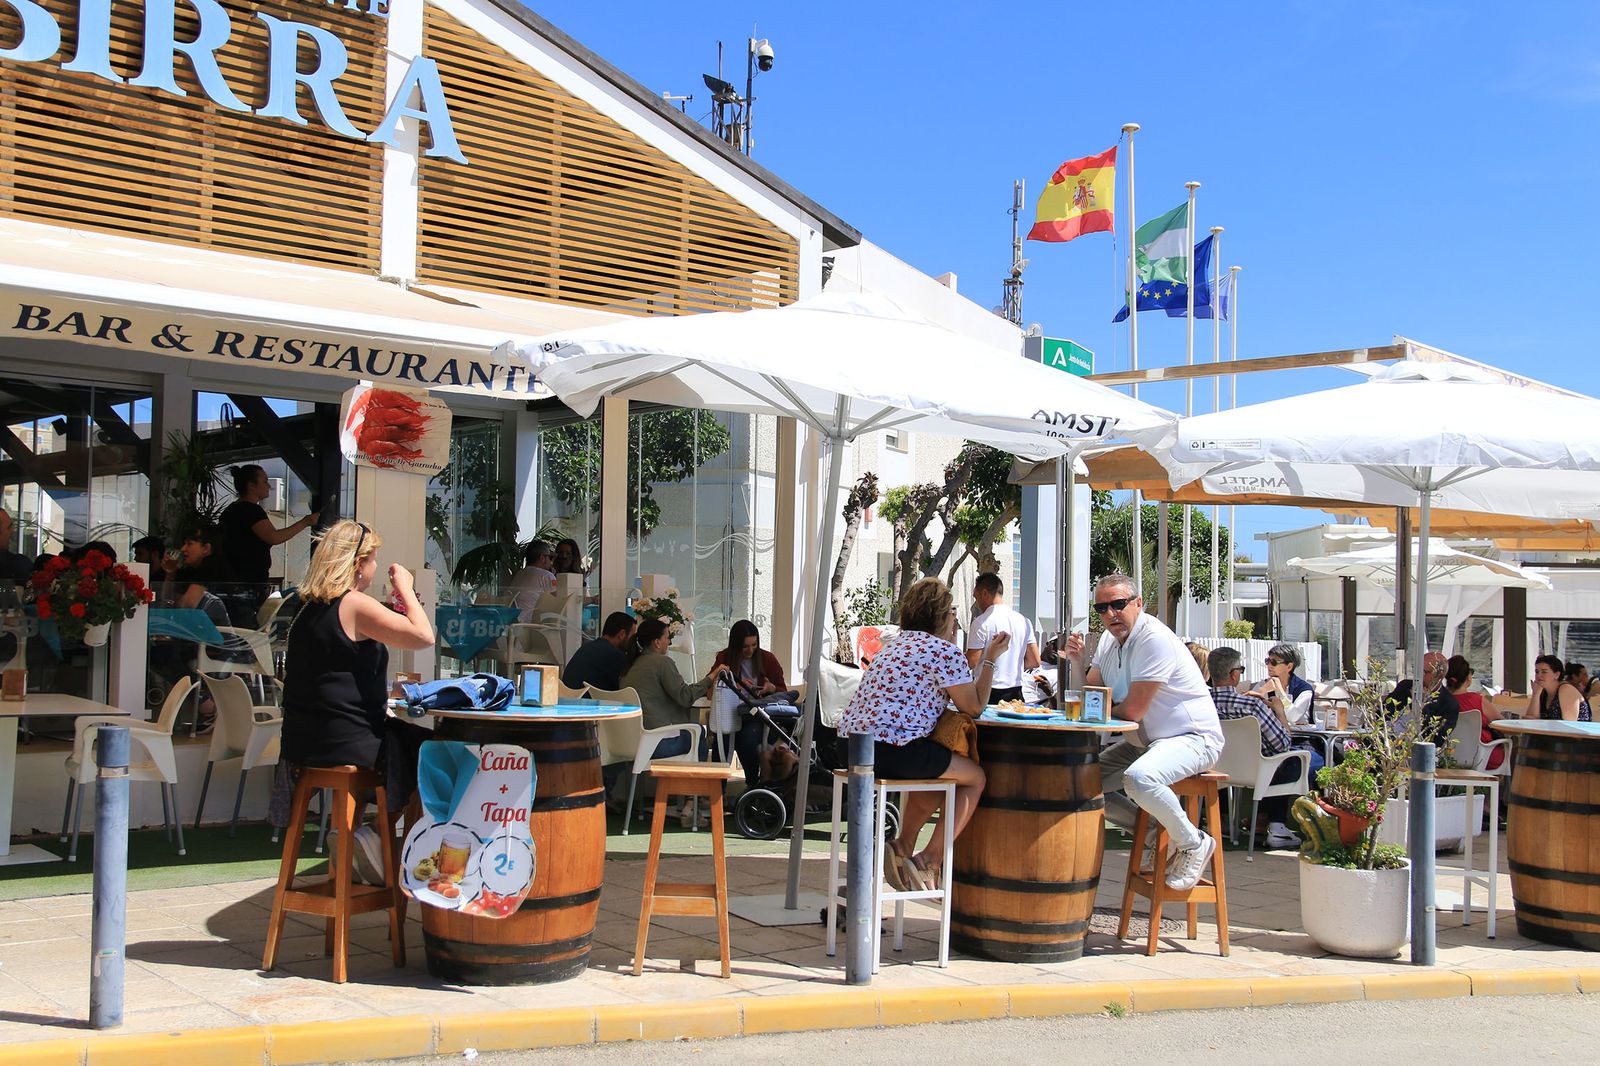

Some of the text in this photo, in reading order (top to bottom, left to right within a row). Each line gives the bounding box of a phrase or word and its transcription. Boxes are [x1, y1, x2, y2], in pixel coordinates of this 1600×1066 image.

[12, 303, 548, 394] BAR & RESTAURANTE
[1031, 409, 1120, 436] AMST
[481, 750, 529, 771] Caña
[480, 802, 528, 828] Tapa
